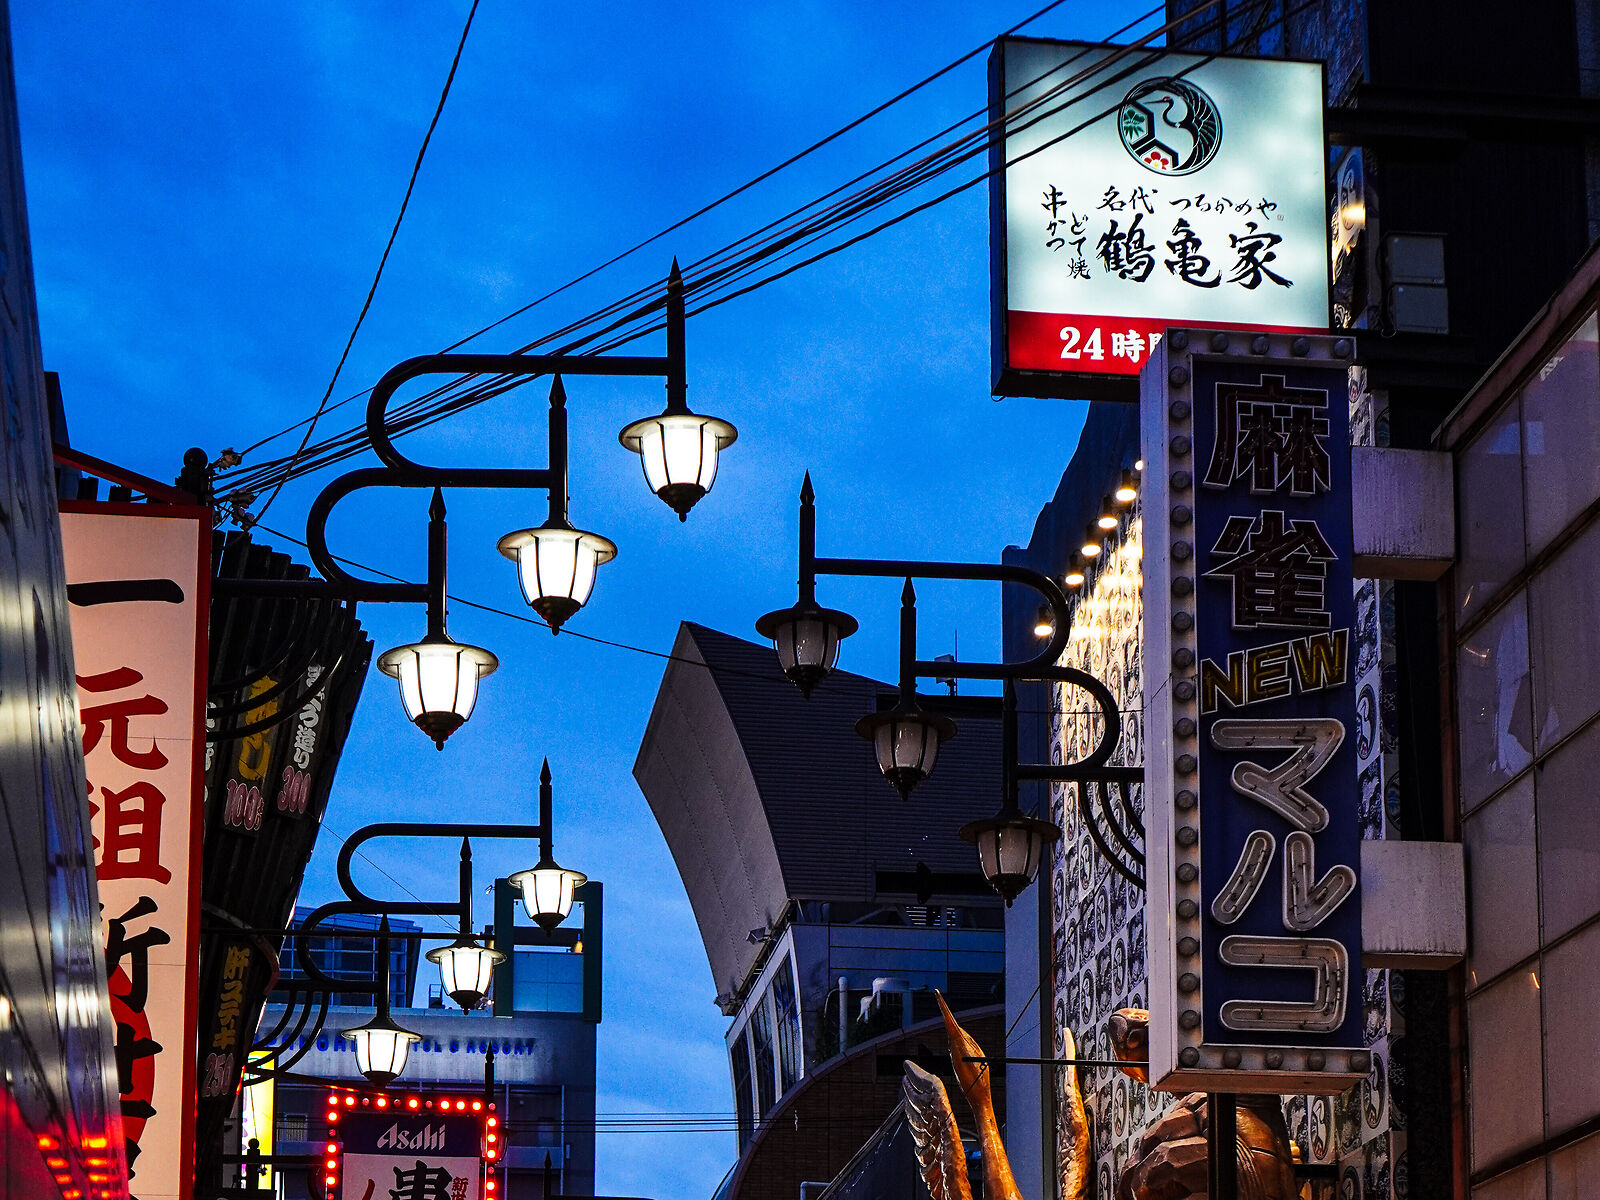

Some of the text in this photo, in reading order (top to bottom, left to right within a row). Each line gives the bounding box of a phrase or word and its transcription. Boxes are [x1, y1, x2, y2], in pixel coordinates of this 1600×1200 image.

[1041, 184, 1067, 252] 串かつ
[1096, 185, 1278, 221] 名代 つるかめや
[1067, 211, 1091, 280] どて焼
[1095, 213, 1294, 290] 鶴亀家
[1202, 373, 1338, 630] 麻雀
[1200, 628, 1349, 715] NEW
[1210, 717, 1356, 1034] マルコ
[377, 1123, 446, 1151] Asahi
